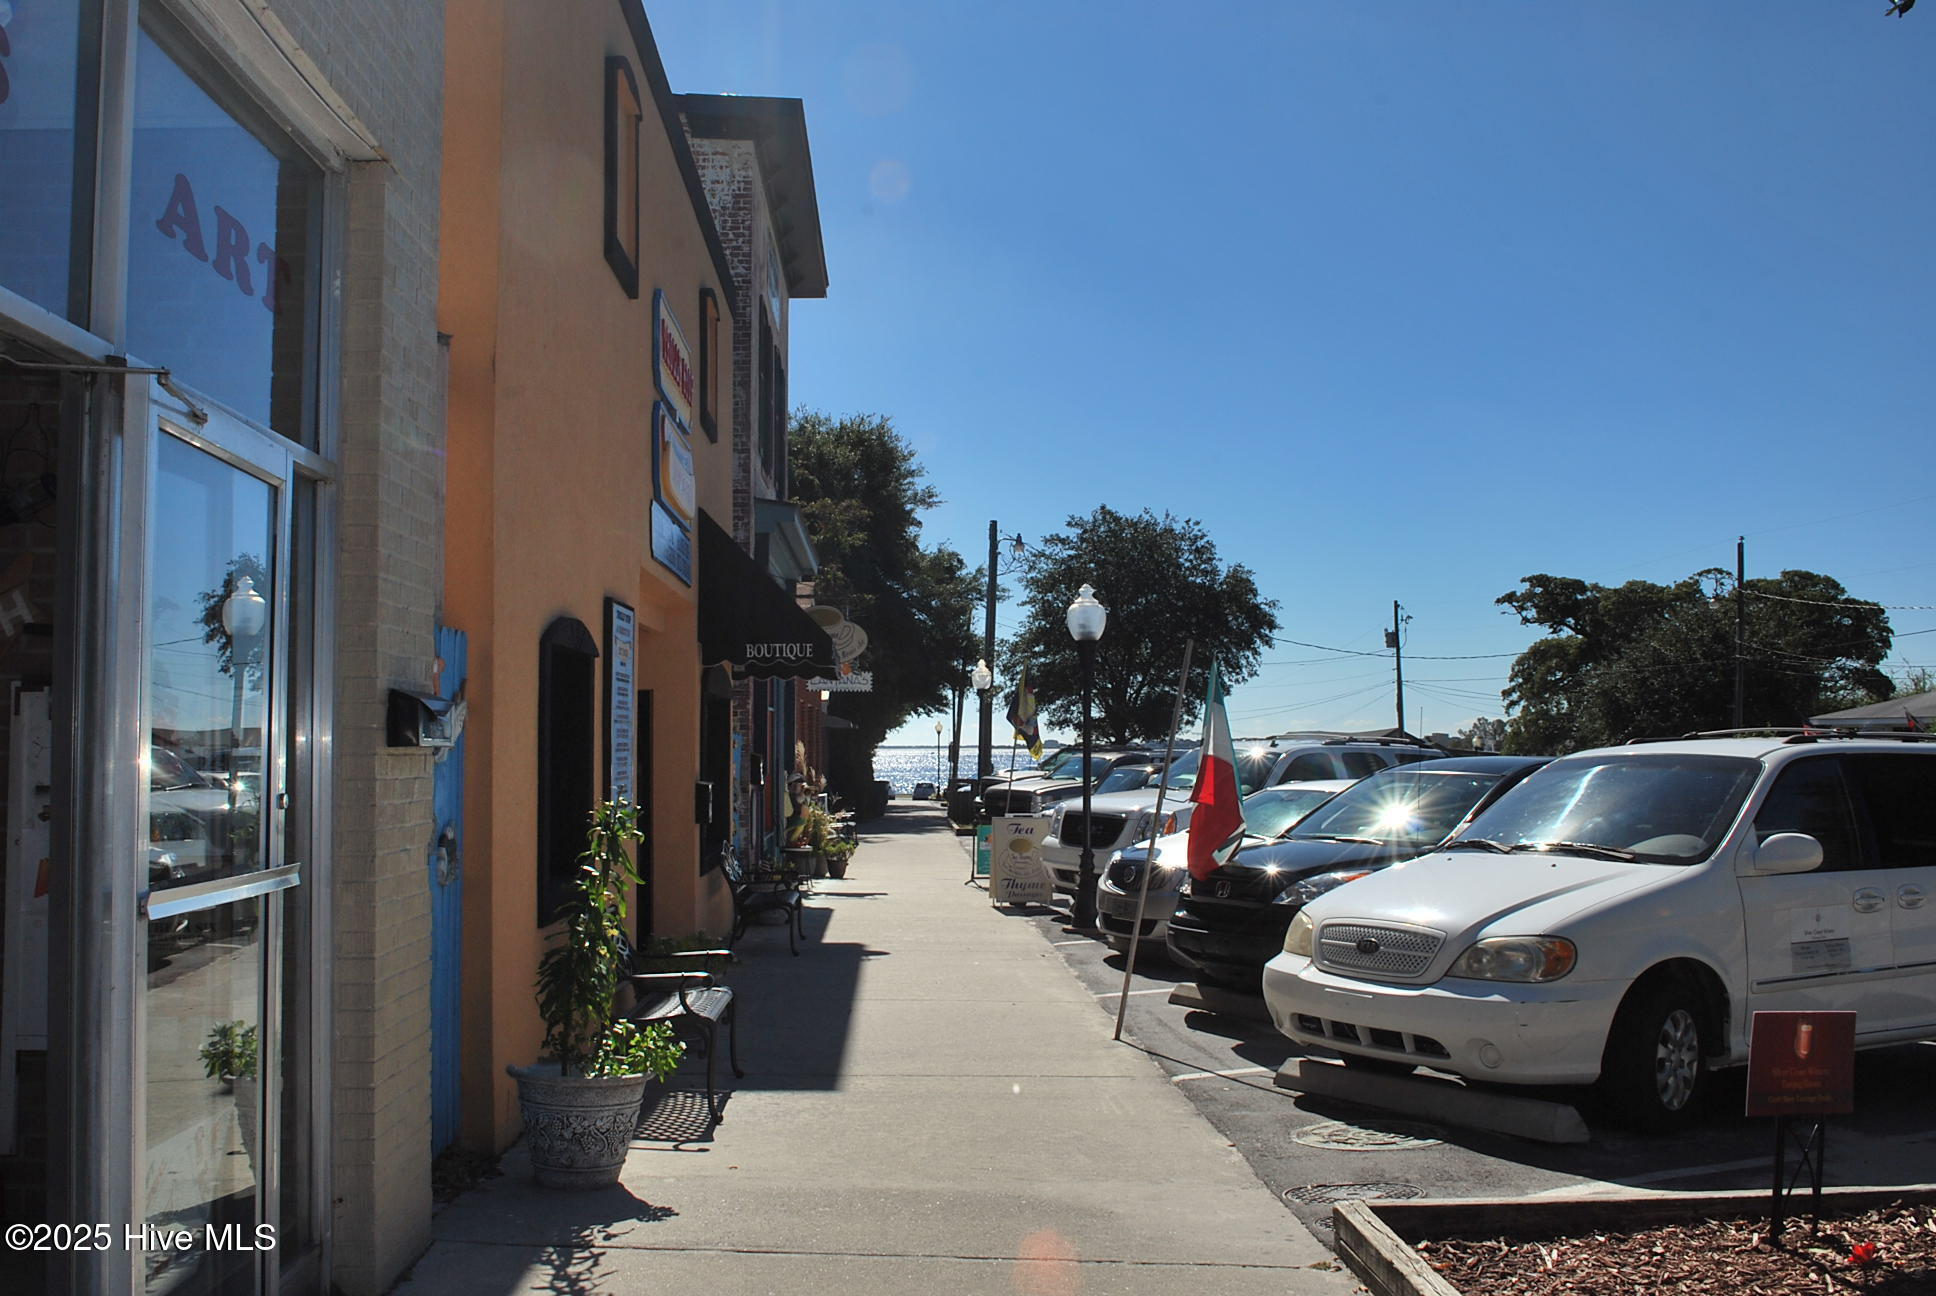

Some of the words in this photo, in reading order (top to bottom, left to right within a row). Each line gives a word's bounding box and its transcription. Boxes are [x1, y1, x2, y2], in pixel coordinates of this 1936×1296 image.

[155, 172, 292, 316] ART
[746, 642, 814, 661] BOUTIQUE
[1007, 822, 1035, 835] Tea
